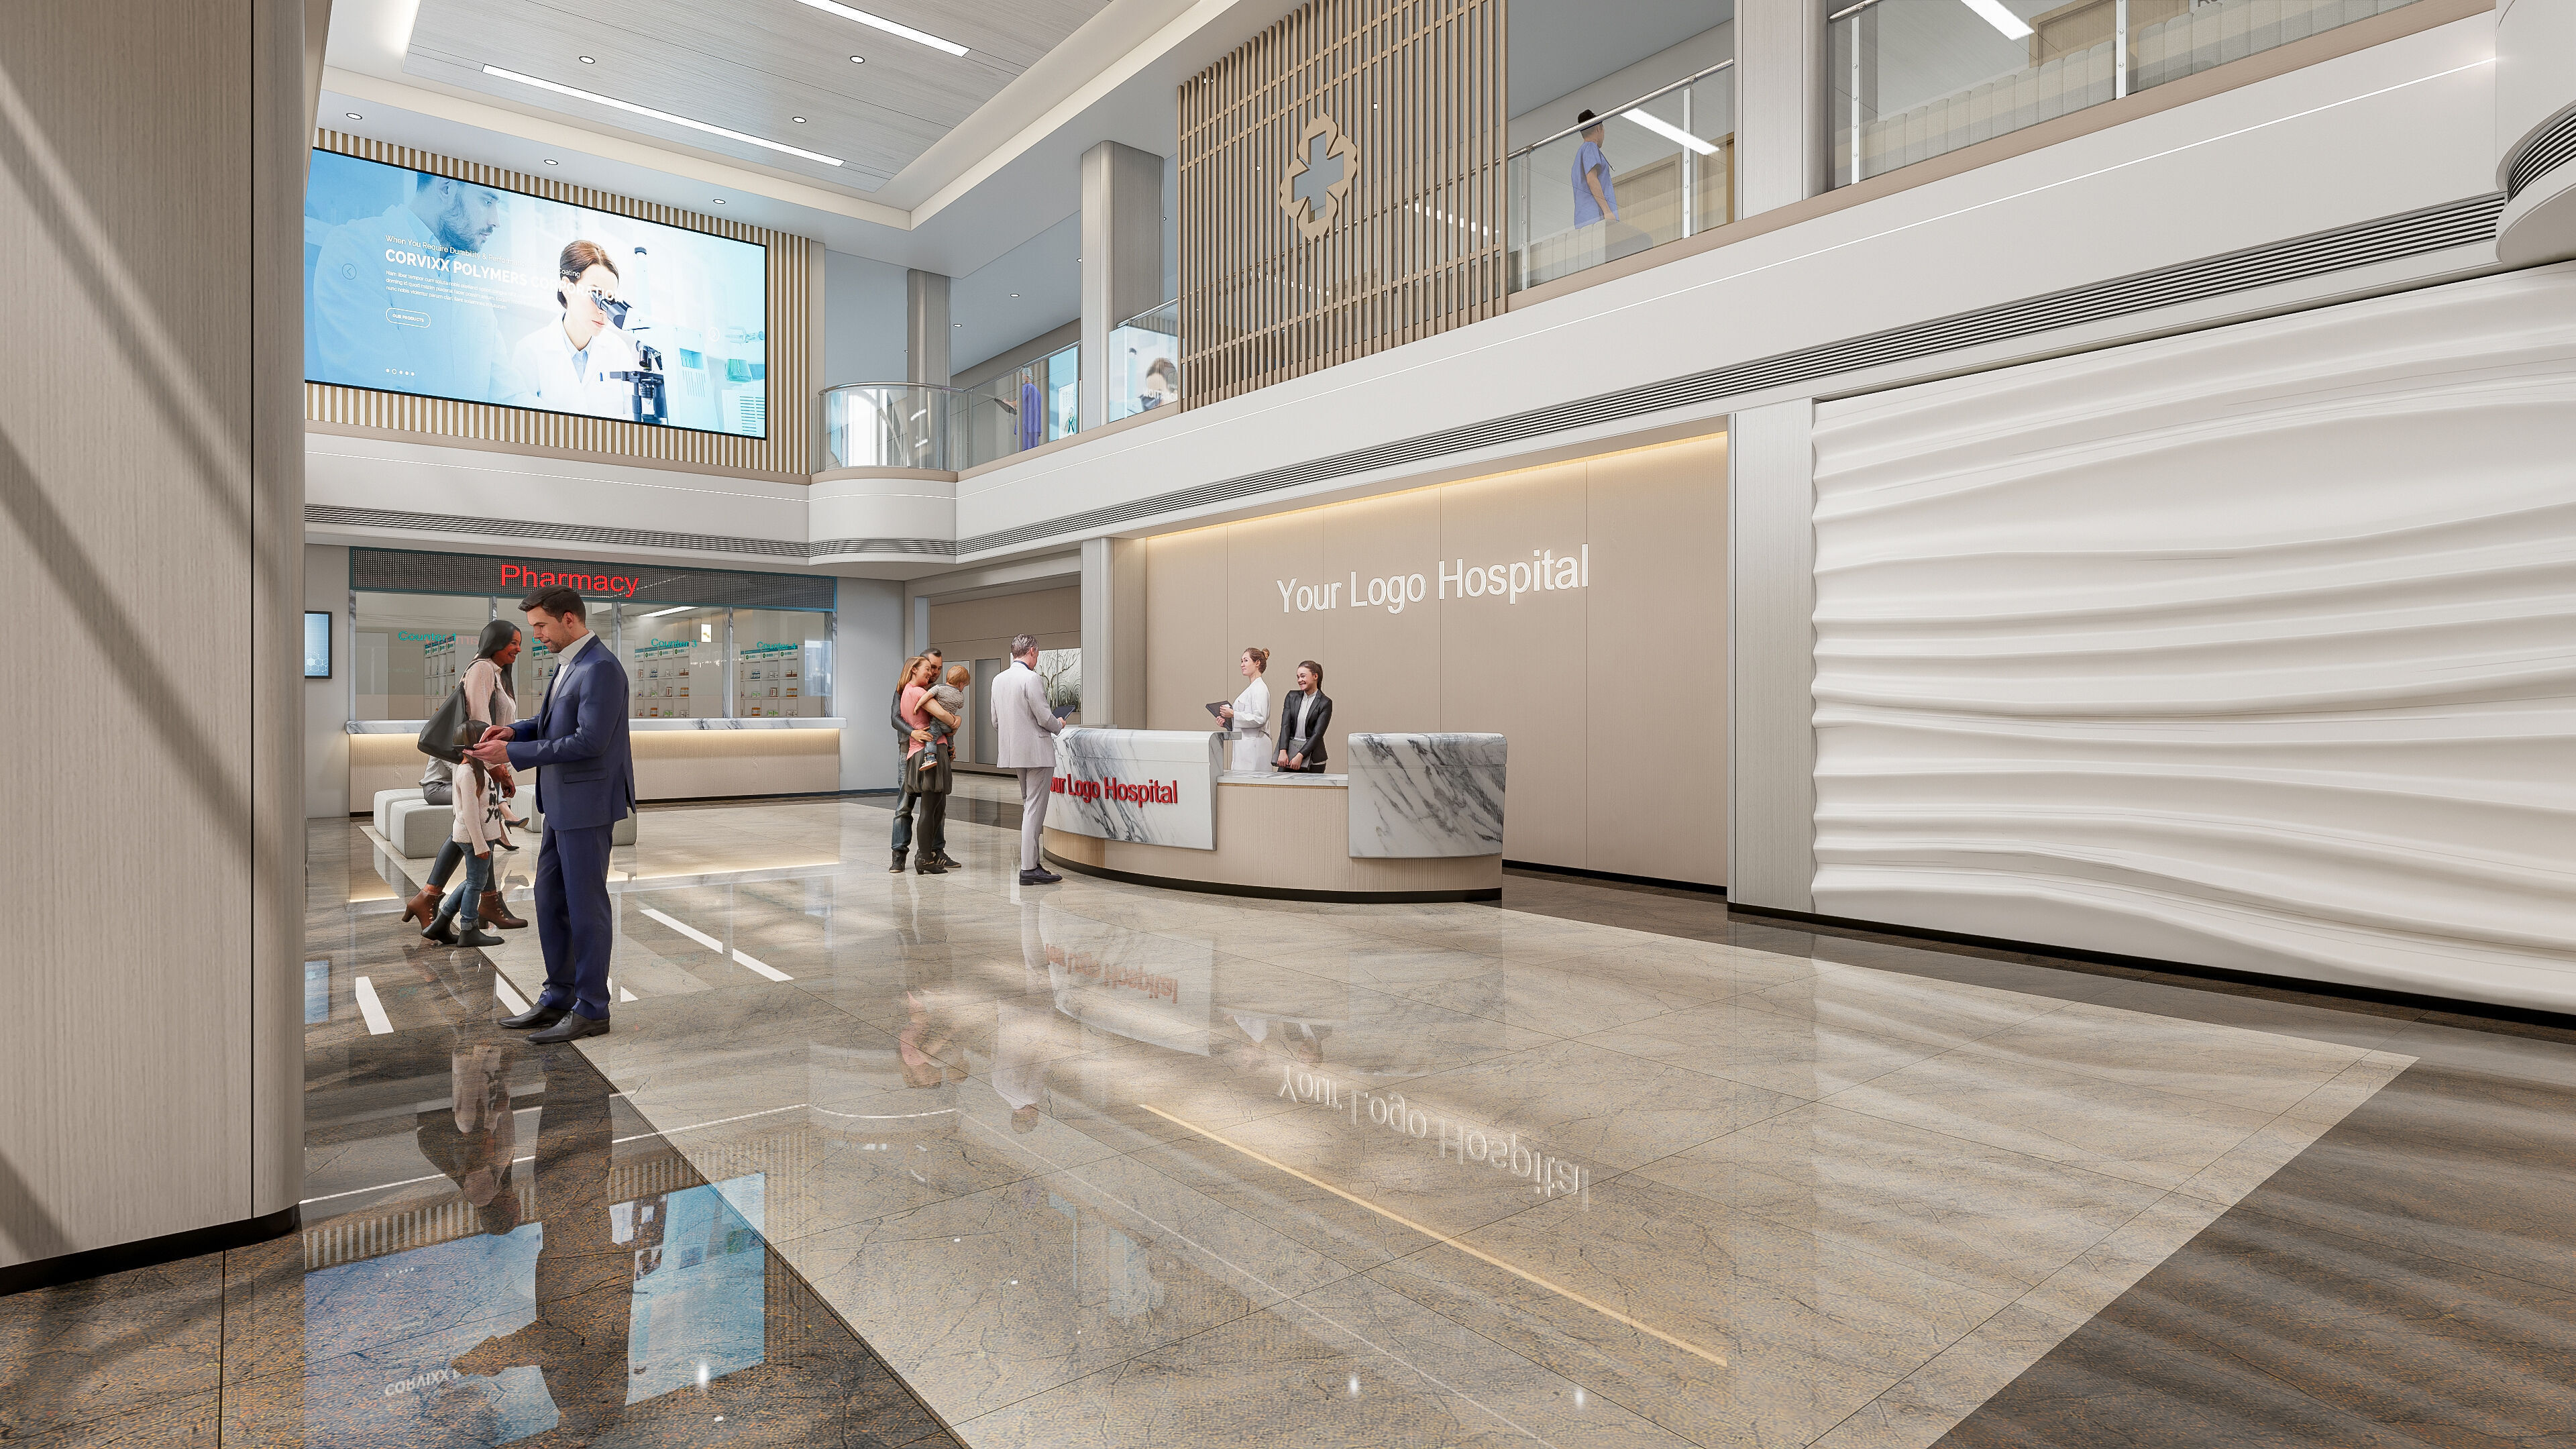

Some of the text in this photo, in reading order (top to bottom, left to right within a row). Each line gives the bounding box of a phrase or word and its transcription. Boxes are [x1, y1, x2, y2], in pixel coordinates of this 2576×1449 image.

[386, 234, 406, 245] When
[407, 238, 421, 248] You
[423, 241, 449, 253] Require
[449, 246, 481, 260] Durability
[385, 249, 450, 272] CORVIXX
[453, 261, 527, 286] POLYMERS
[531, 275, 623, 303] CORPORATION
[386, 278, 403, 286] doming
[402, 315, 425, 323] PRODUCTS
[501, 564, 639, 598] Pharmacy
[1276, 543, 1589, 614] Your Logo Hospital
[398, 630, 447, 641] Counter
[651, 638, 698, 648] Counter 3
[757, 641, 789, 650] Counter
[1050, 773, 1178, 808] our Logo Hospital
